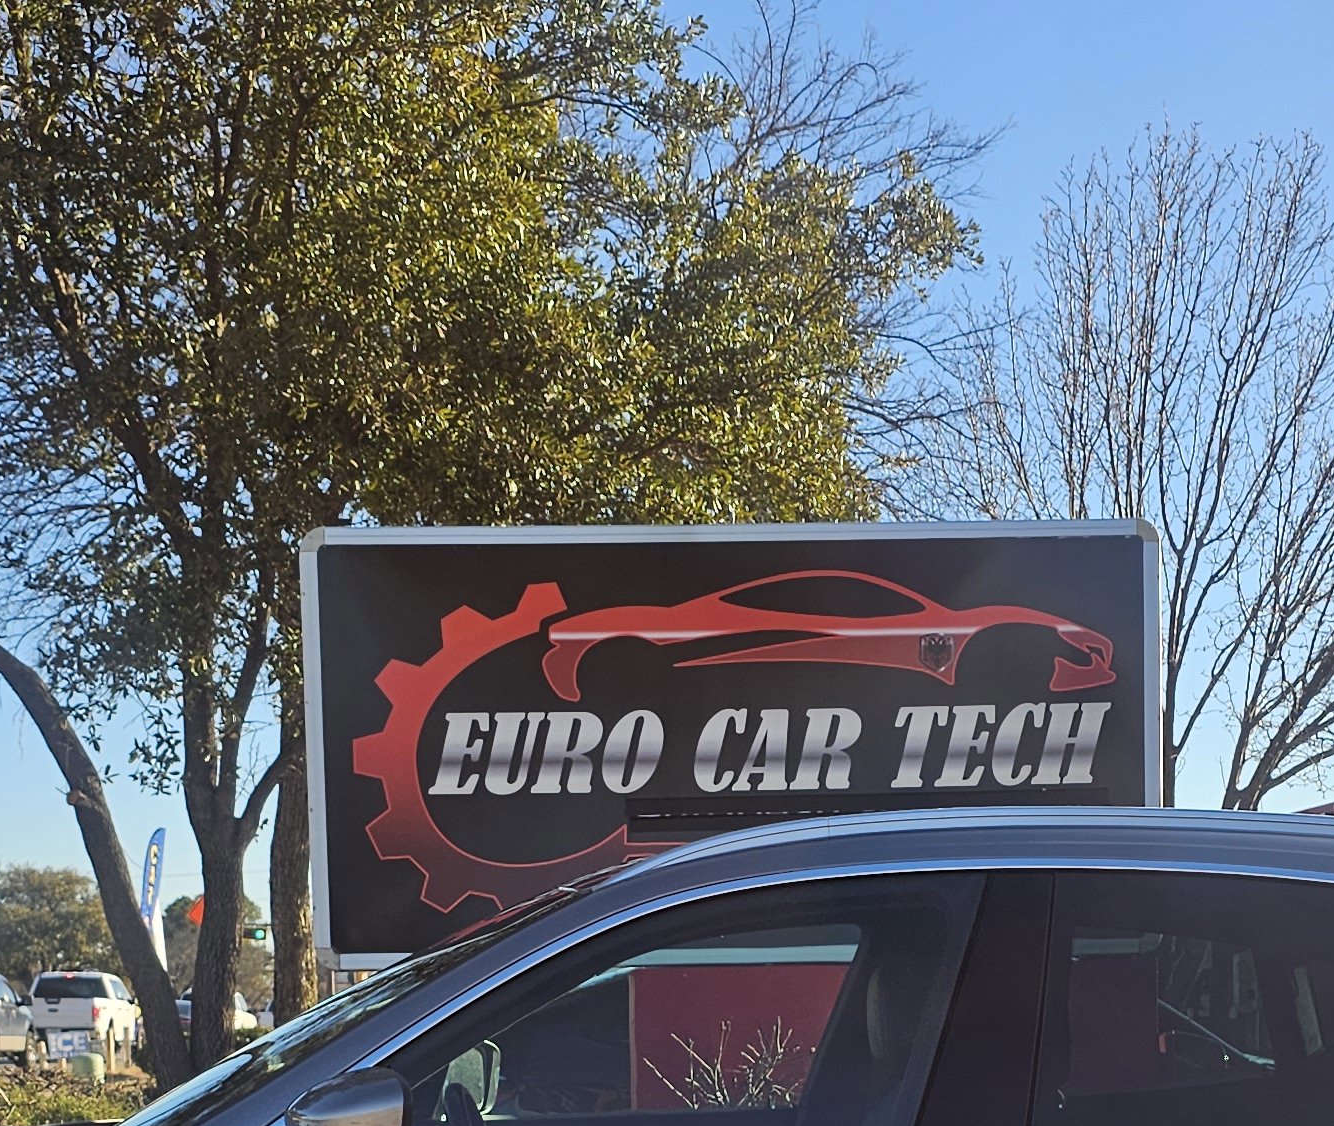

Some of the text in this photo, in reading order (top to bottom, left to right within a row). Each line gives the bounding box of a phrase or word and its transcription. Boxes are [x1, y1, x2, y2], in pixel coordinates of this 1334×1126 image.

[428, 701, 1112, 796] EURO CAR TECH
